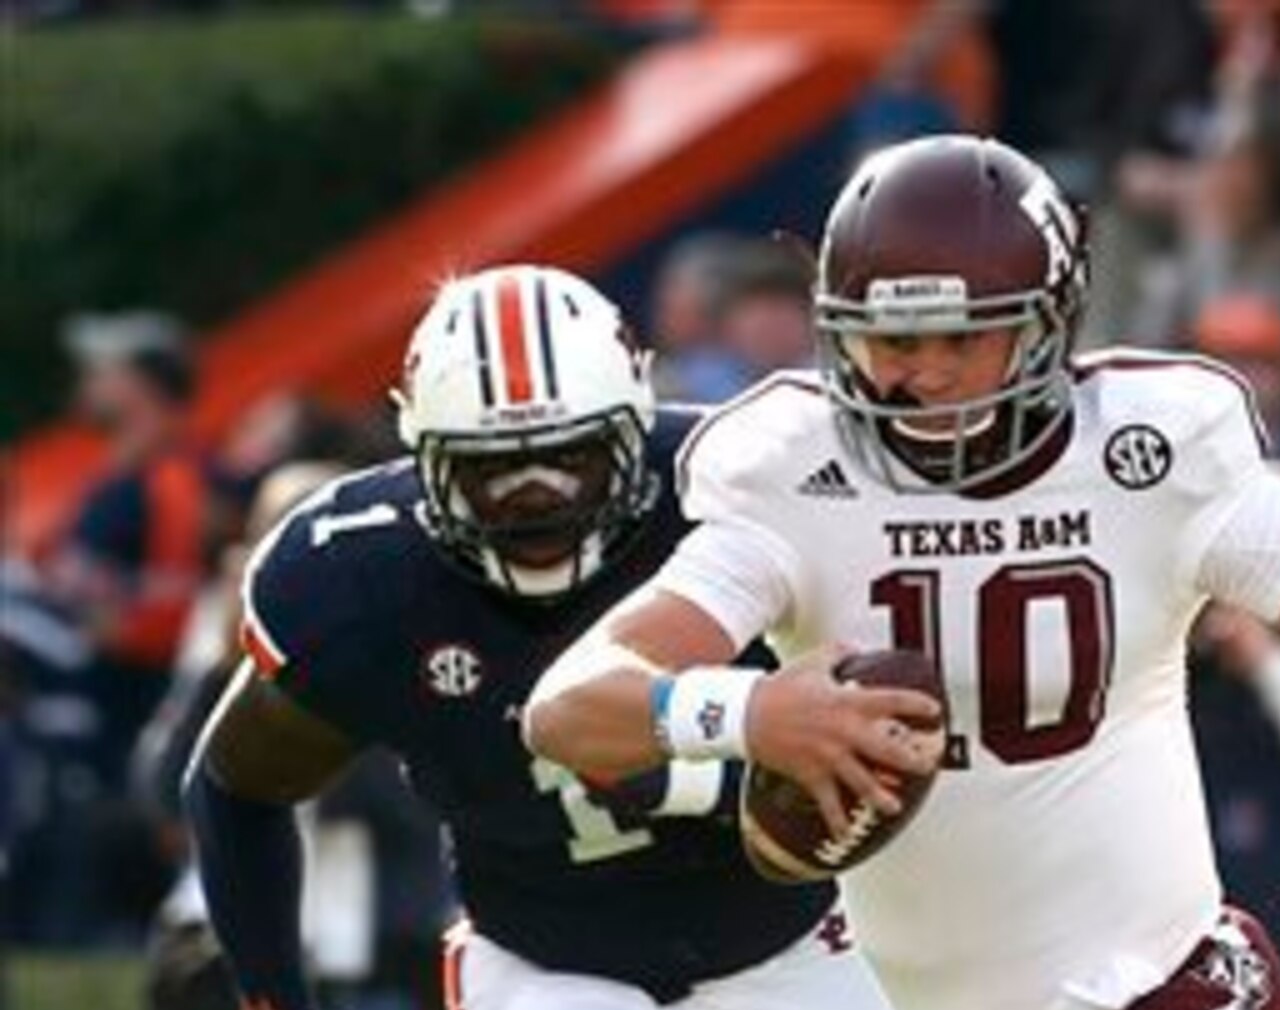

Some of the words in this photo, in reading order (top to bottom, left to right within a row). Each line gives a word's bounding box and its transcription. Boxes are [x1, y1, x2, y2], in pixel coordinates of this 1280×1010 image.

[1107, 428, 1169, 486] SEC
[313, 504, 398, 546] 1
[883, 518, 1004, 557] TEXAS
[1017, 509, 1091, 550] A&M
[427, 646, 482, 696] SEC
[869, 556, 1116, 771] 10
[531, 757, 654, 864] 1
